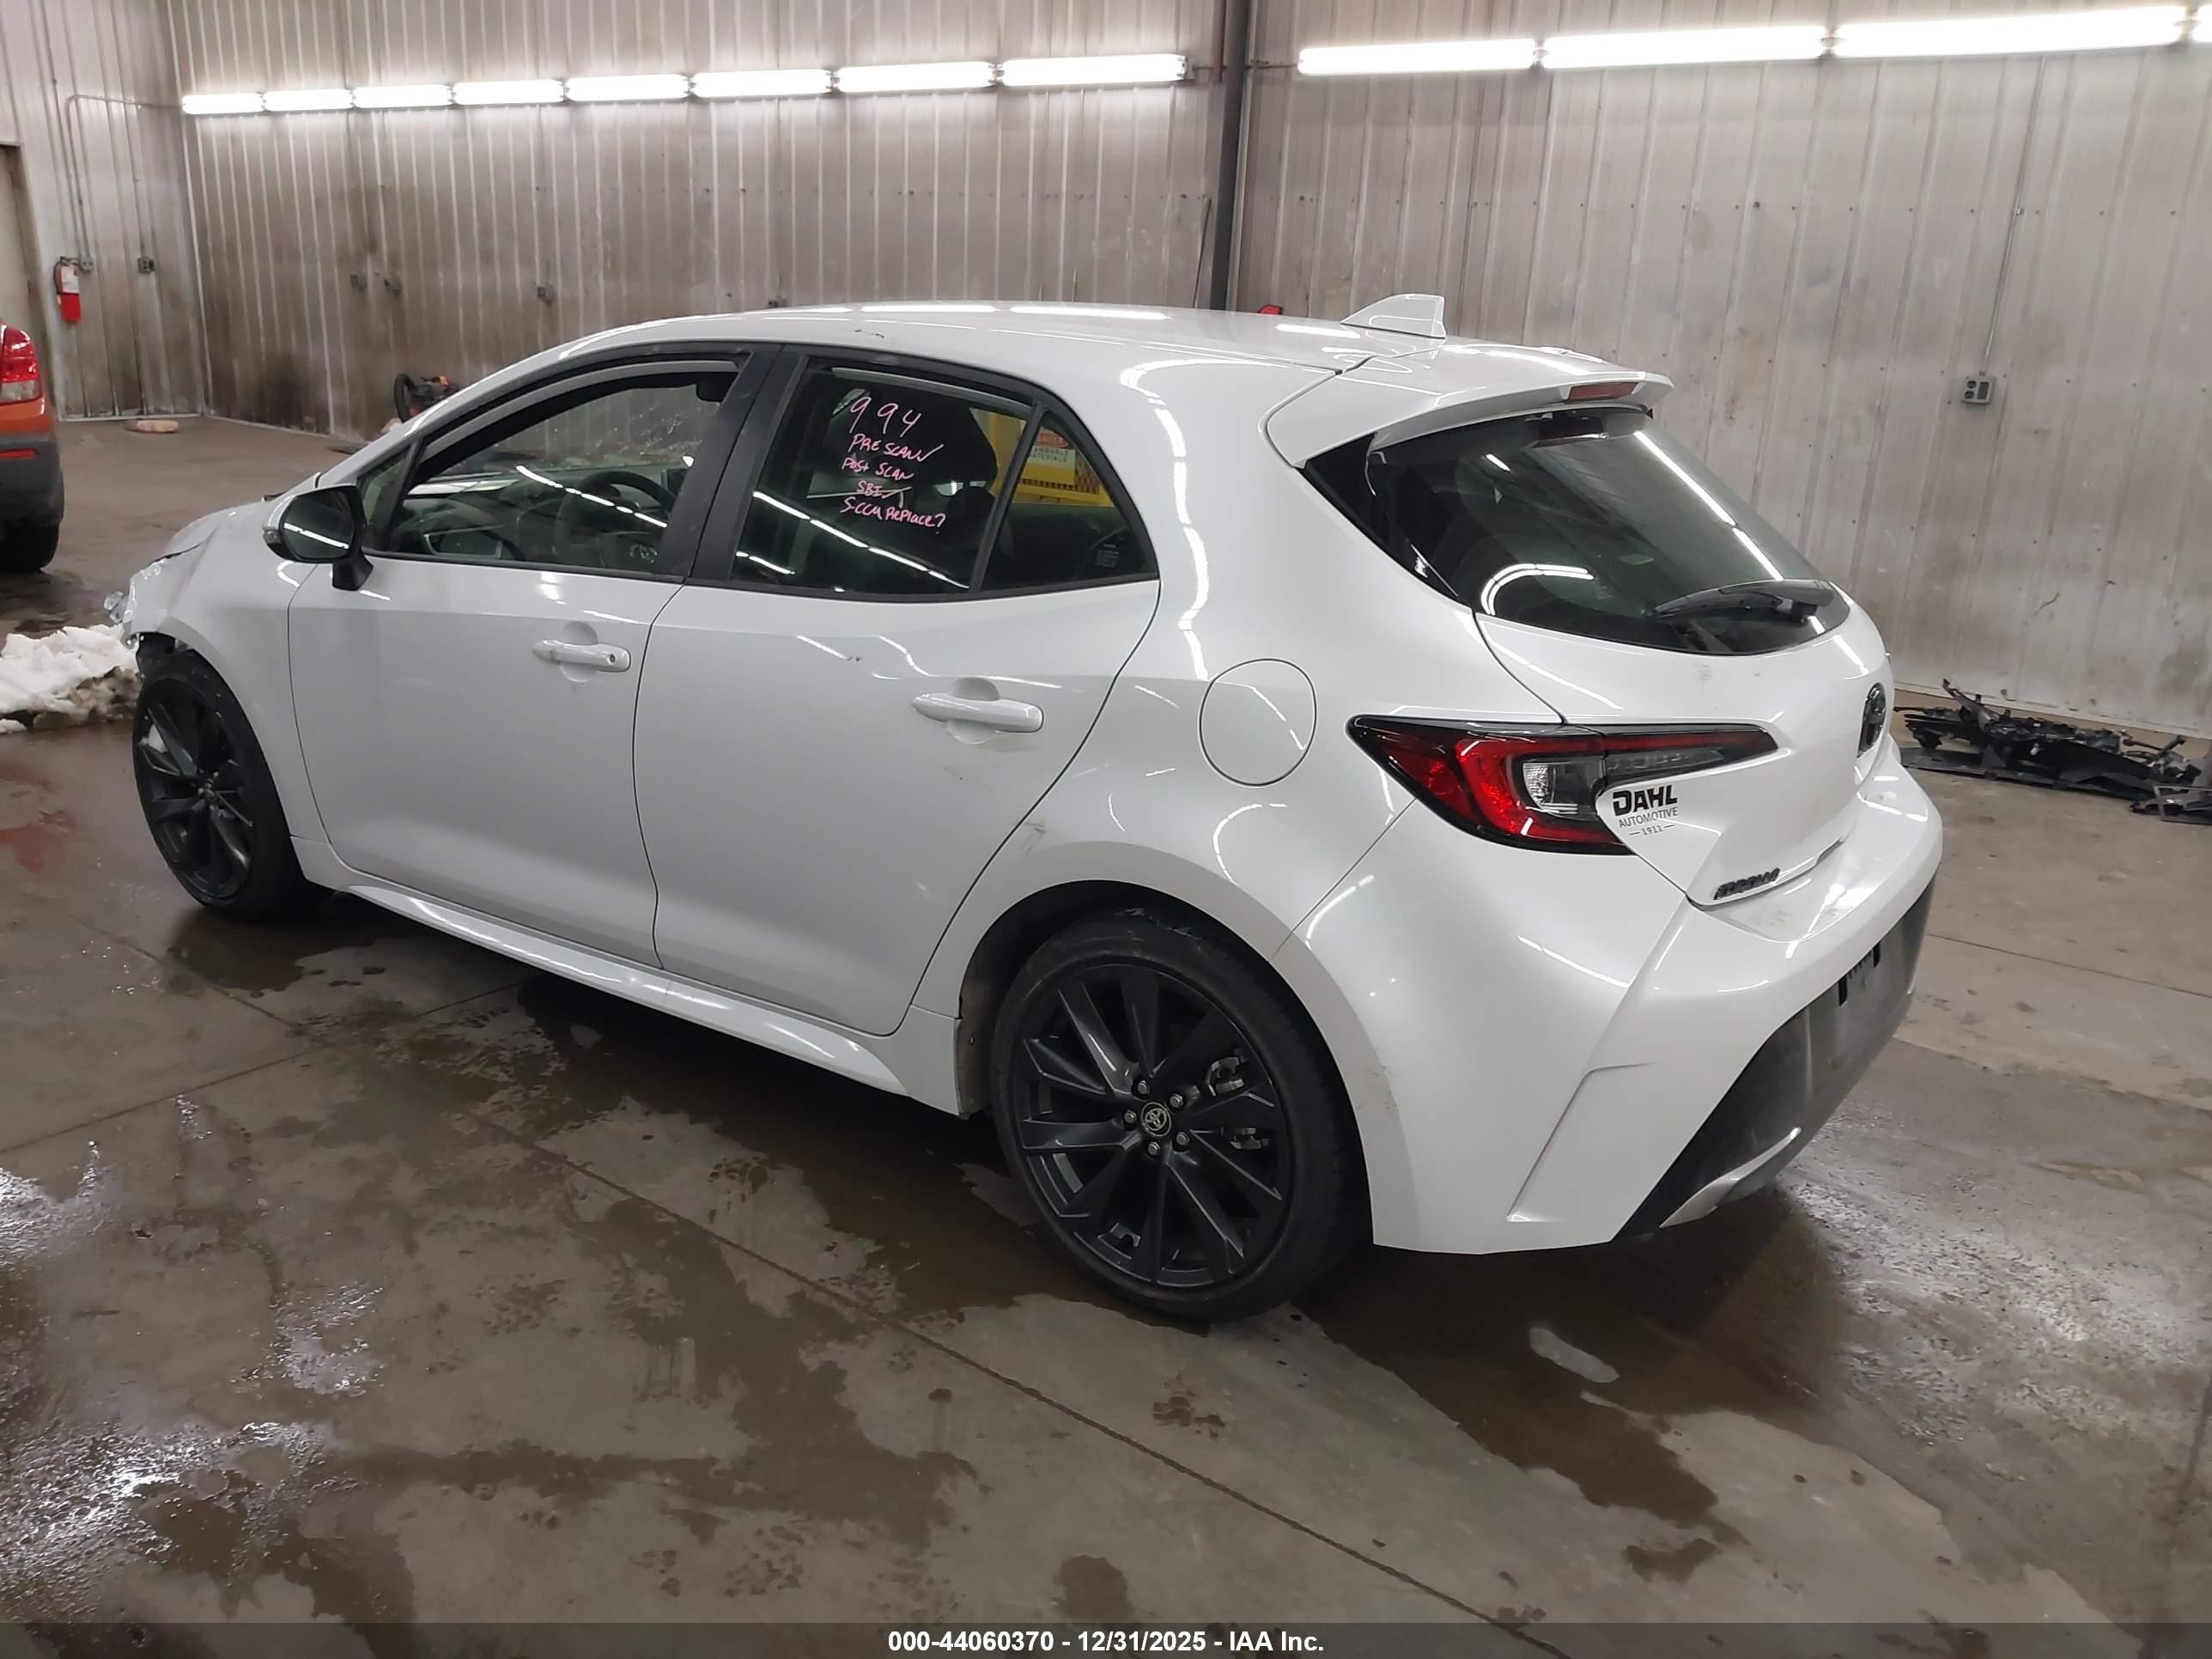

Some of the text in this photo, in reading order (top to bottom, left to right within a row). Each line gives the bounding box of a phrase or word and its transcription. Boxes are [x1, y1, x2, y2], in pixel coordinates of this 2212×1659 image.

[849, 396, 922, 438] 994
[848, 433, 923, 460] PRE SCAN
[1613, 785, 1678, 817] DAHL
[1619, 806, 1678, 828] AUTOMOTIVE
[1641, 825, 1663, 836] 1911
